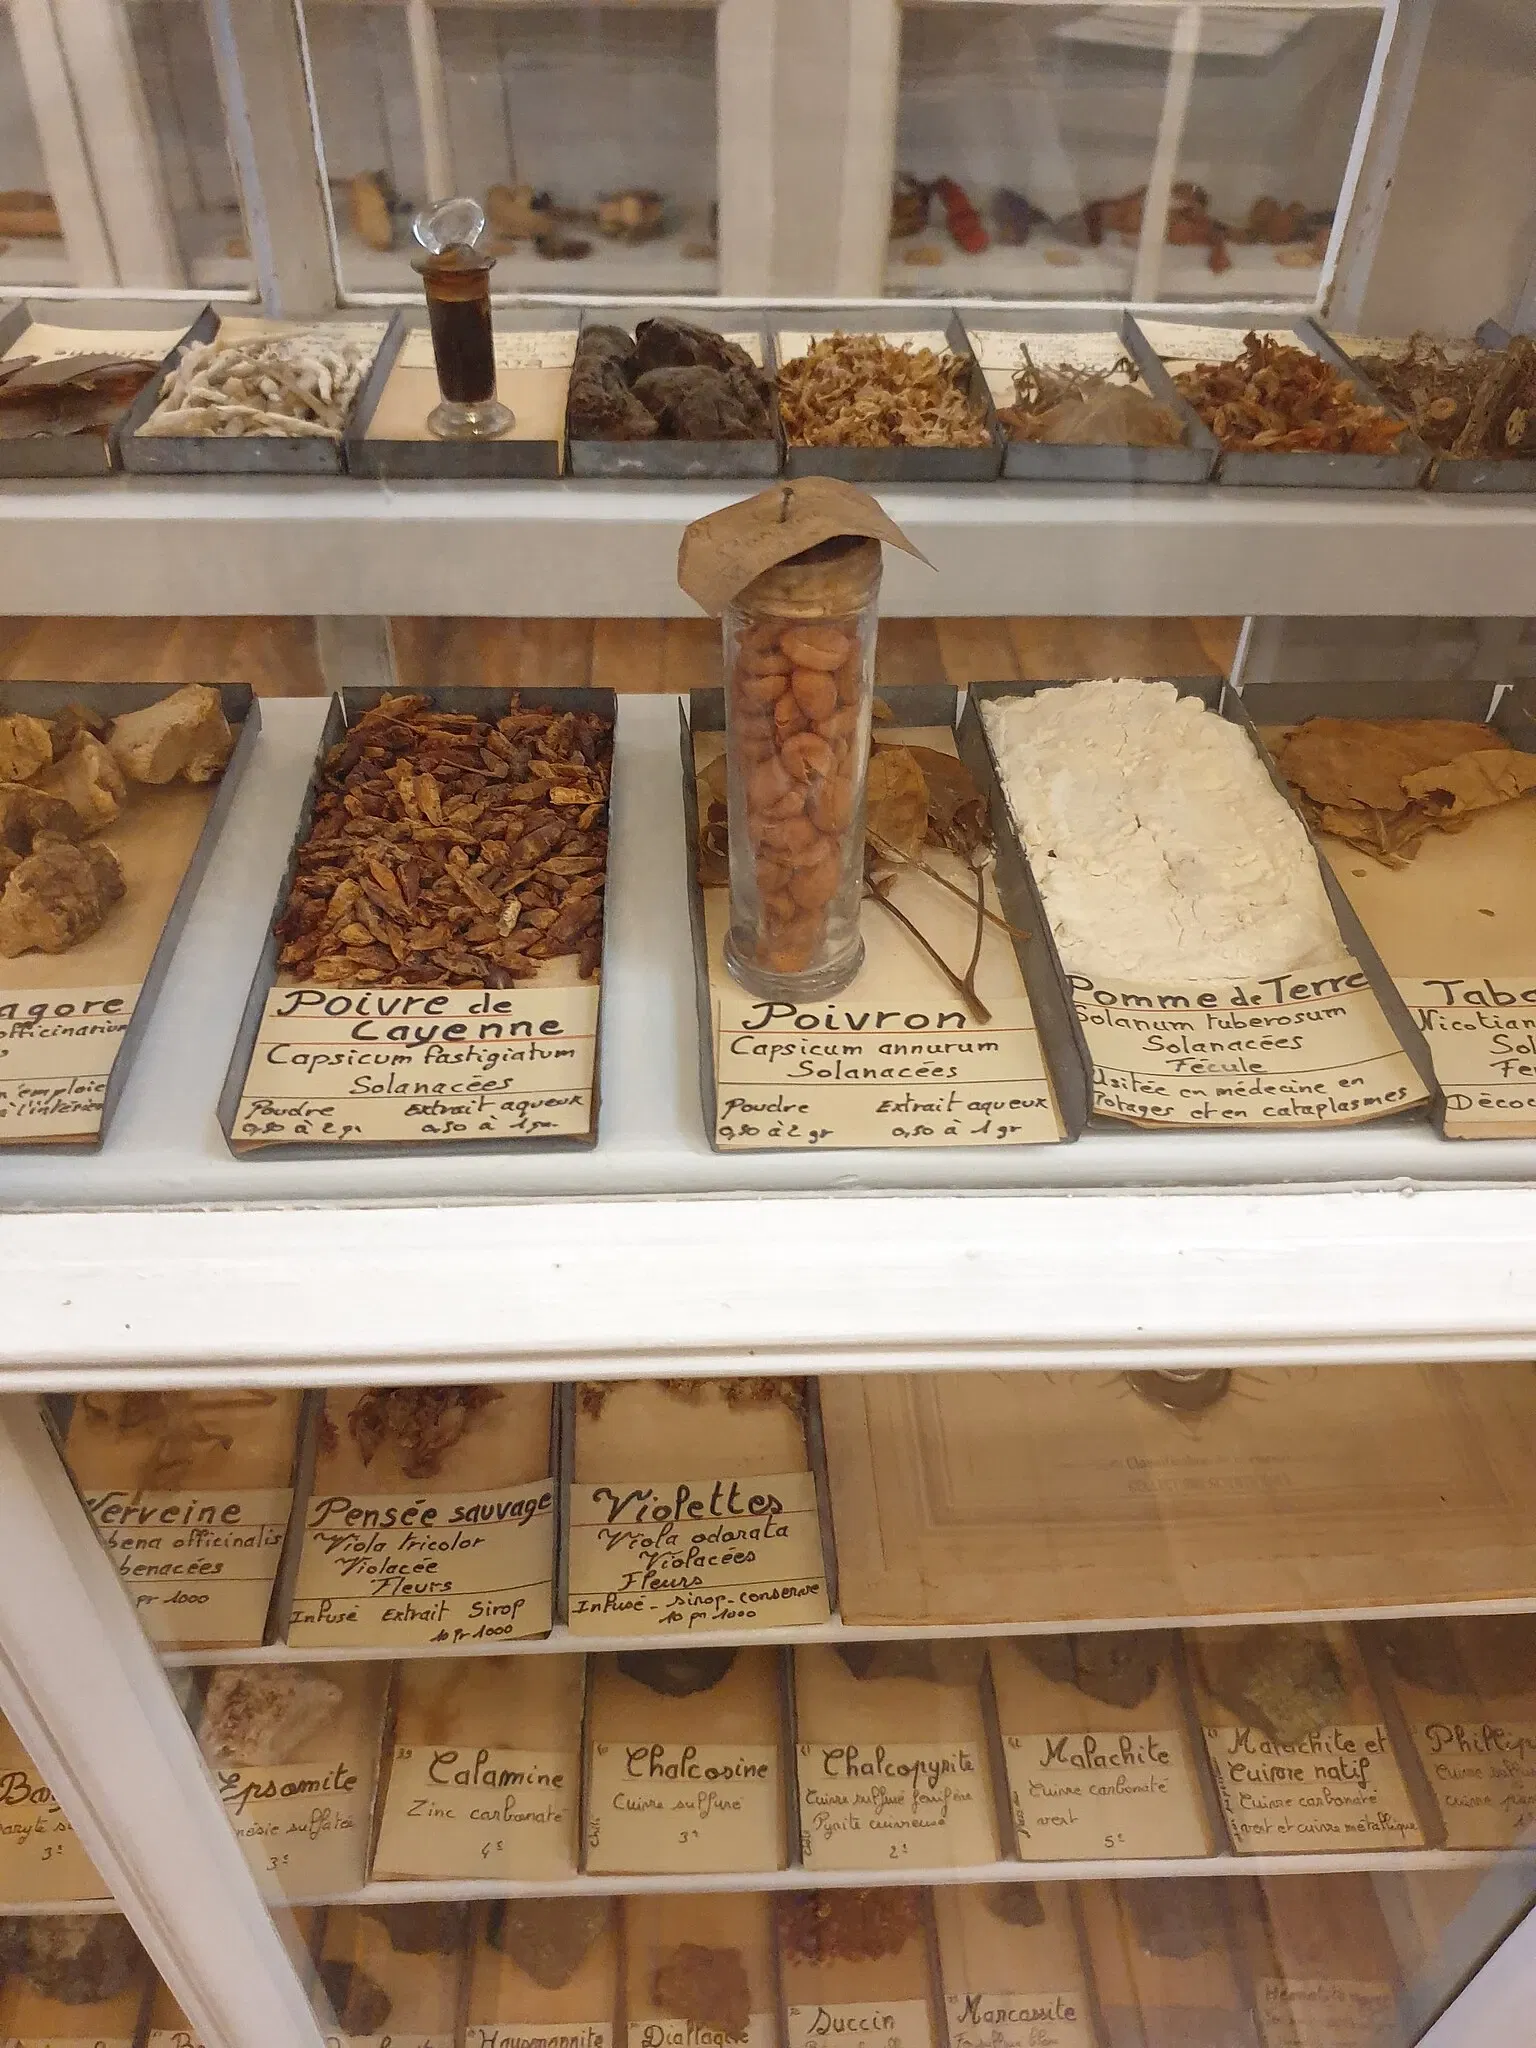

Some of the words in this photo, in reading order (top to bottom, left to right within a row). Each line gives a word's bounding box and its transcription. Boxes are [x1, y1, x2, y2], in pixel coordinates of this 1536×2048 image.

[277, 990, 448, 1016] Poivre
[469, 992, 512, 1014] de
[1065, 974, 1217, 1009] Pomme
[1230, 986, 1262, 1006] de
[1258, 972, 1368, 1004] Terre
[741, 1002, 966, 1031] Poivron
[1076, 1005, 1194, 1031] Solanum
[1207, 1007, 1346, 1030] tuberosum
[351, 1019, 564, 1049] Cayenne
[1143, 1035, 1303, 1054] Solanacées
[267, 1044, 412, 1074] Capsicum
[424, 1042, 575, 1071] fastigiatum
[730, 1036, 862, 1062] Capsicum
[878, 1042, 999, 1055] annurum
[787, 1059, 958, 1080] Solanacées
[1166, 1057, 1267, 1074] Fécule
[349, 1072, 514, 1095] Solanacées
[1180, 1088, 1207, 1098] en
[1216, 1077, 1327, 1097] médecine
[1338, 1076, 1364, 1088] en
[244, 1100, 335, 1120] Poudre
[404, 1096, 495, 1117] Extrait
[500, 1095, 583, 1118] aqueux
[721, 1095, 809, 1120] Poudre
[875, 1091, 963, 1113] Extrait
[967, 1097, 1049, 1115] aqueux
[1094, 1091, 1174, 1118] Potages
[1191, 1101, 1217, 1119] et
[1222, 1107, 1247, 1118] en
[1263, 1087, 1408, 1119] cataplasmes
[294, 1119, 313, 1134] à
[322, 1122, 337, 1134] 2
[479, 1115, 498, 1131] à
[768, 1120, 784, 1137] à
[787, 1124, 801, 1137] 2
[808, 1128, 834, 1144] gr
[892, 1124, 935, 1138] 0,50
[944, 1119, 961, 1135] à
[971, 1120, 992, 1134] 1
[996, 1125, 1022, 1139] gr
[86, 1492, 242, 1525] Verveine
[308, 1497, 438, 1528] Pensée
[448, 1492, 551, 1526] sauvage
[592, 1480, 783, 1523] Violettes
[173, 1525, 282, 1549] officinalis
[314, 1532, 387, 1554] Viola
[398, 1531, 485, 1551] tricolor
[598, 1522, 677, 1551] Viola
[691, 1514, 790, 1544] odorata
[335, 1556, 438, 1576] Violacée
[639, 1546, 757, 1571] Violacées
[371, 1576, 452, 1596] Fleurs
[618, 1570, 704, 1591] Fleurs
[163, 1590, 210, 1605] 1000
[572, 1592, 644, 1613] Infusé
[289, 1599, 359, 1624] Infusé
[381, 1600, 450, 1622] Extrait
[468, 1599, 525, 1620] Sirop
[659, 1610, 683, 1624] 10
[712, 1608, 757, 1620] 1000
[472, 1624, 513, 1638] 1000
[1039, 1734, 1170, 1768] Malachite
[1365, 1726, 1389, 1754] et
[428, 1749, 565, 1788] Calamine
[626, 1743, 769, 1780] Chalcosine
[822, 1744, 976, 1789] Chalcopyrite
[1228, 1761, 1304, 1783] Cuivre
[1314, 1757, 1370, 1789] natif
[407, 1800, 456, 1819] Zinc
[806, 2006, 895, 2036] Succin
[957, 1994, 1078, 2025] Marcassite
